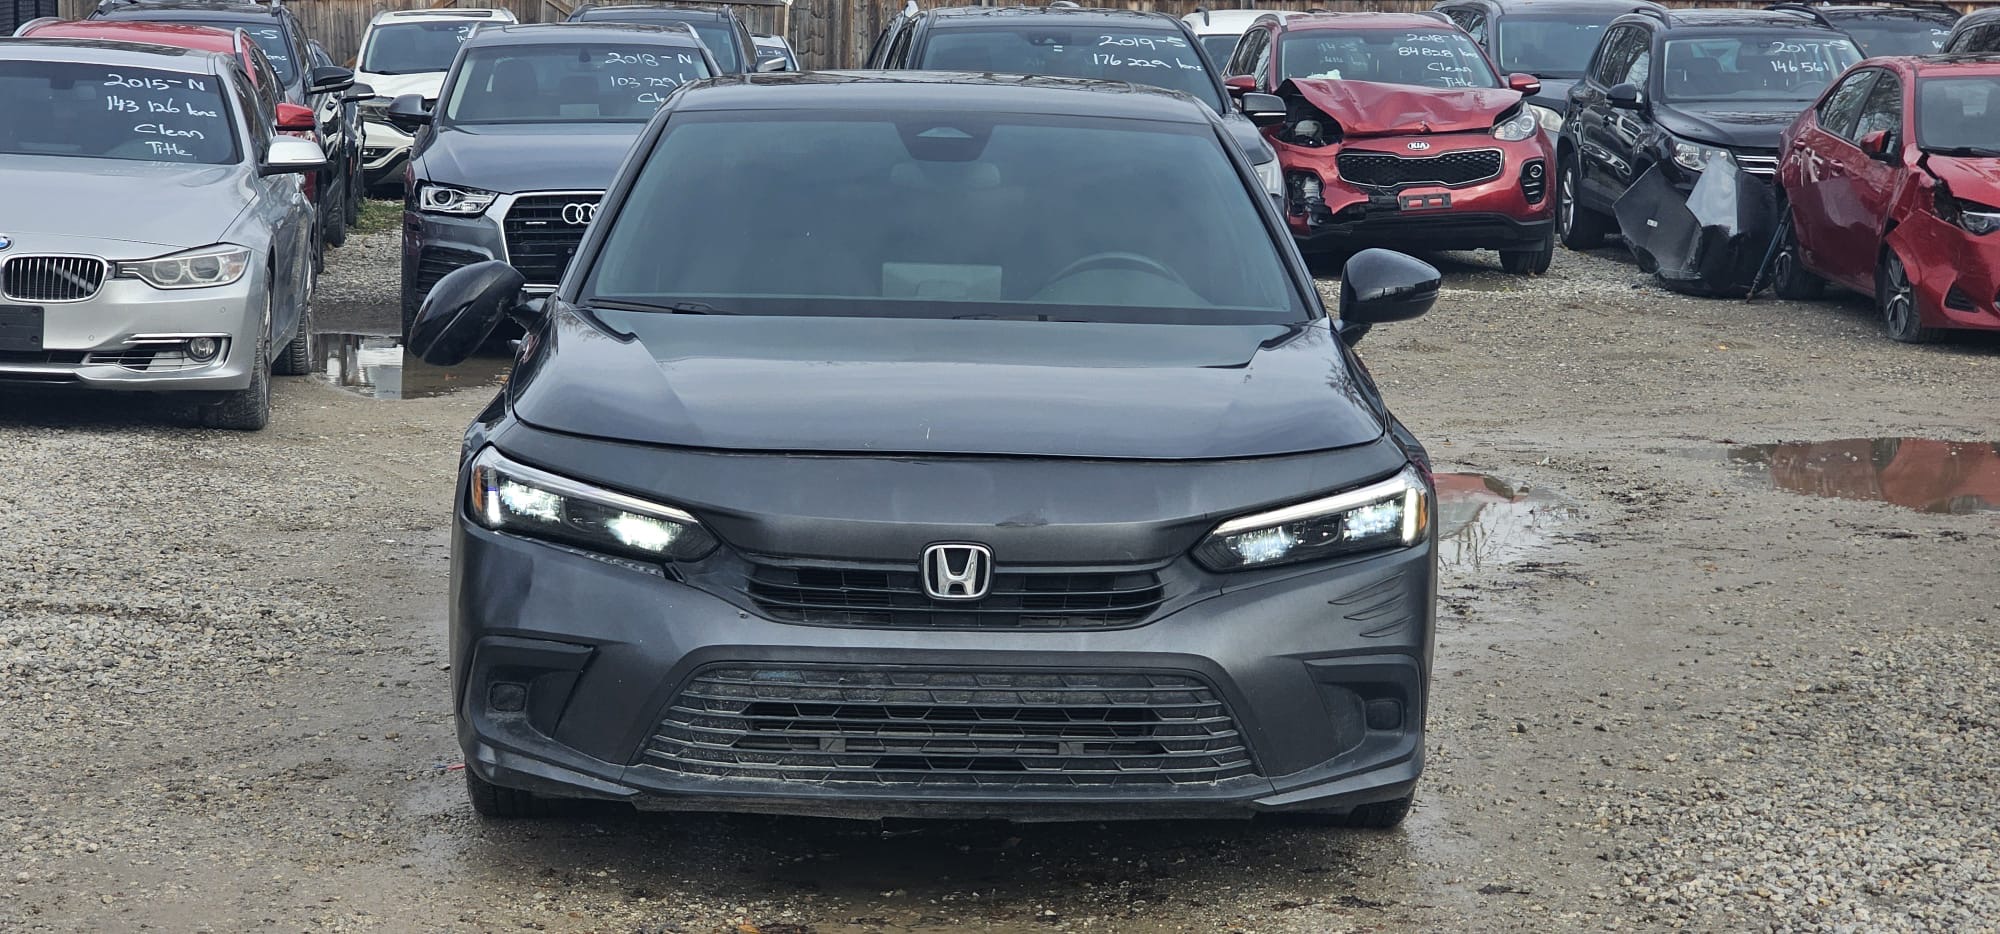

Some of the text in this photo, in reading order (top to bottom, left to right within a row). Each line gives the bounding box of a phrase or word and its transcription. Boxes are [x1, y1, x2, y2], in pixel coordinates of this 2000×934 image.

[1398, 46, 1419, 57] 84
[1421, 47, 1454, 58] 828
[1093, 53, 1122, 66] 176
[1127, 57, 1172, 69] 229
[1427, 62, 1473, 73] Clean
[1770, 60, 1798, 73] 146
[1800, 61, 1830, 73] 561
[610, 75, 641, 88] 103
[643, 77, 679, 88] 729
[1440, 76, 1479, 88] Title
[106, 95, 141, 113] 143
[147, 97, 180, 113] 126
[134, 123, 205, 140] Clean
[144, 141, 193, 156] Title
[1408, 141, 1430, 150] KIA
